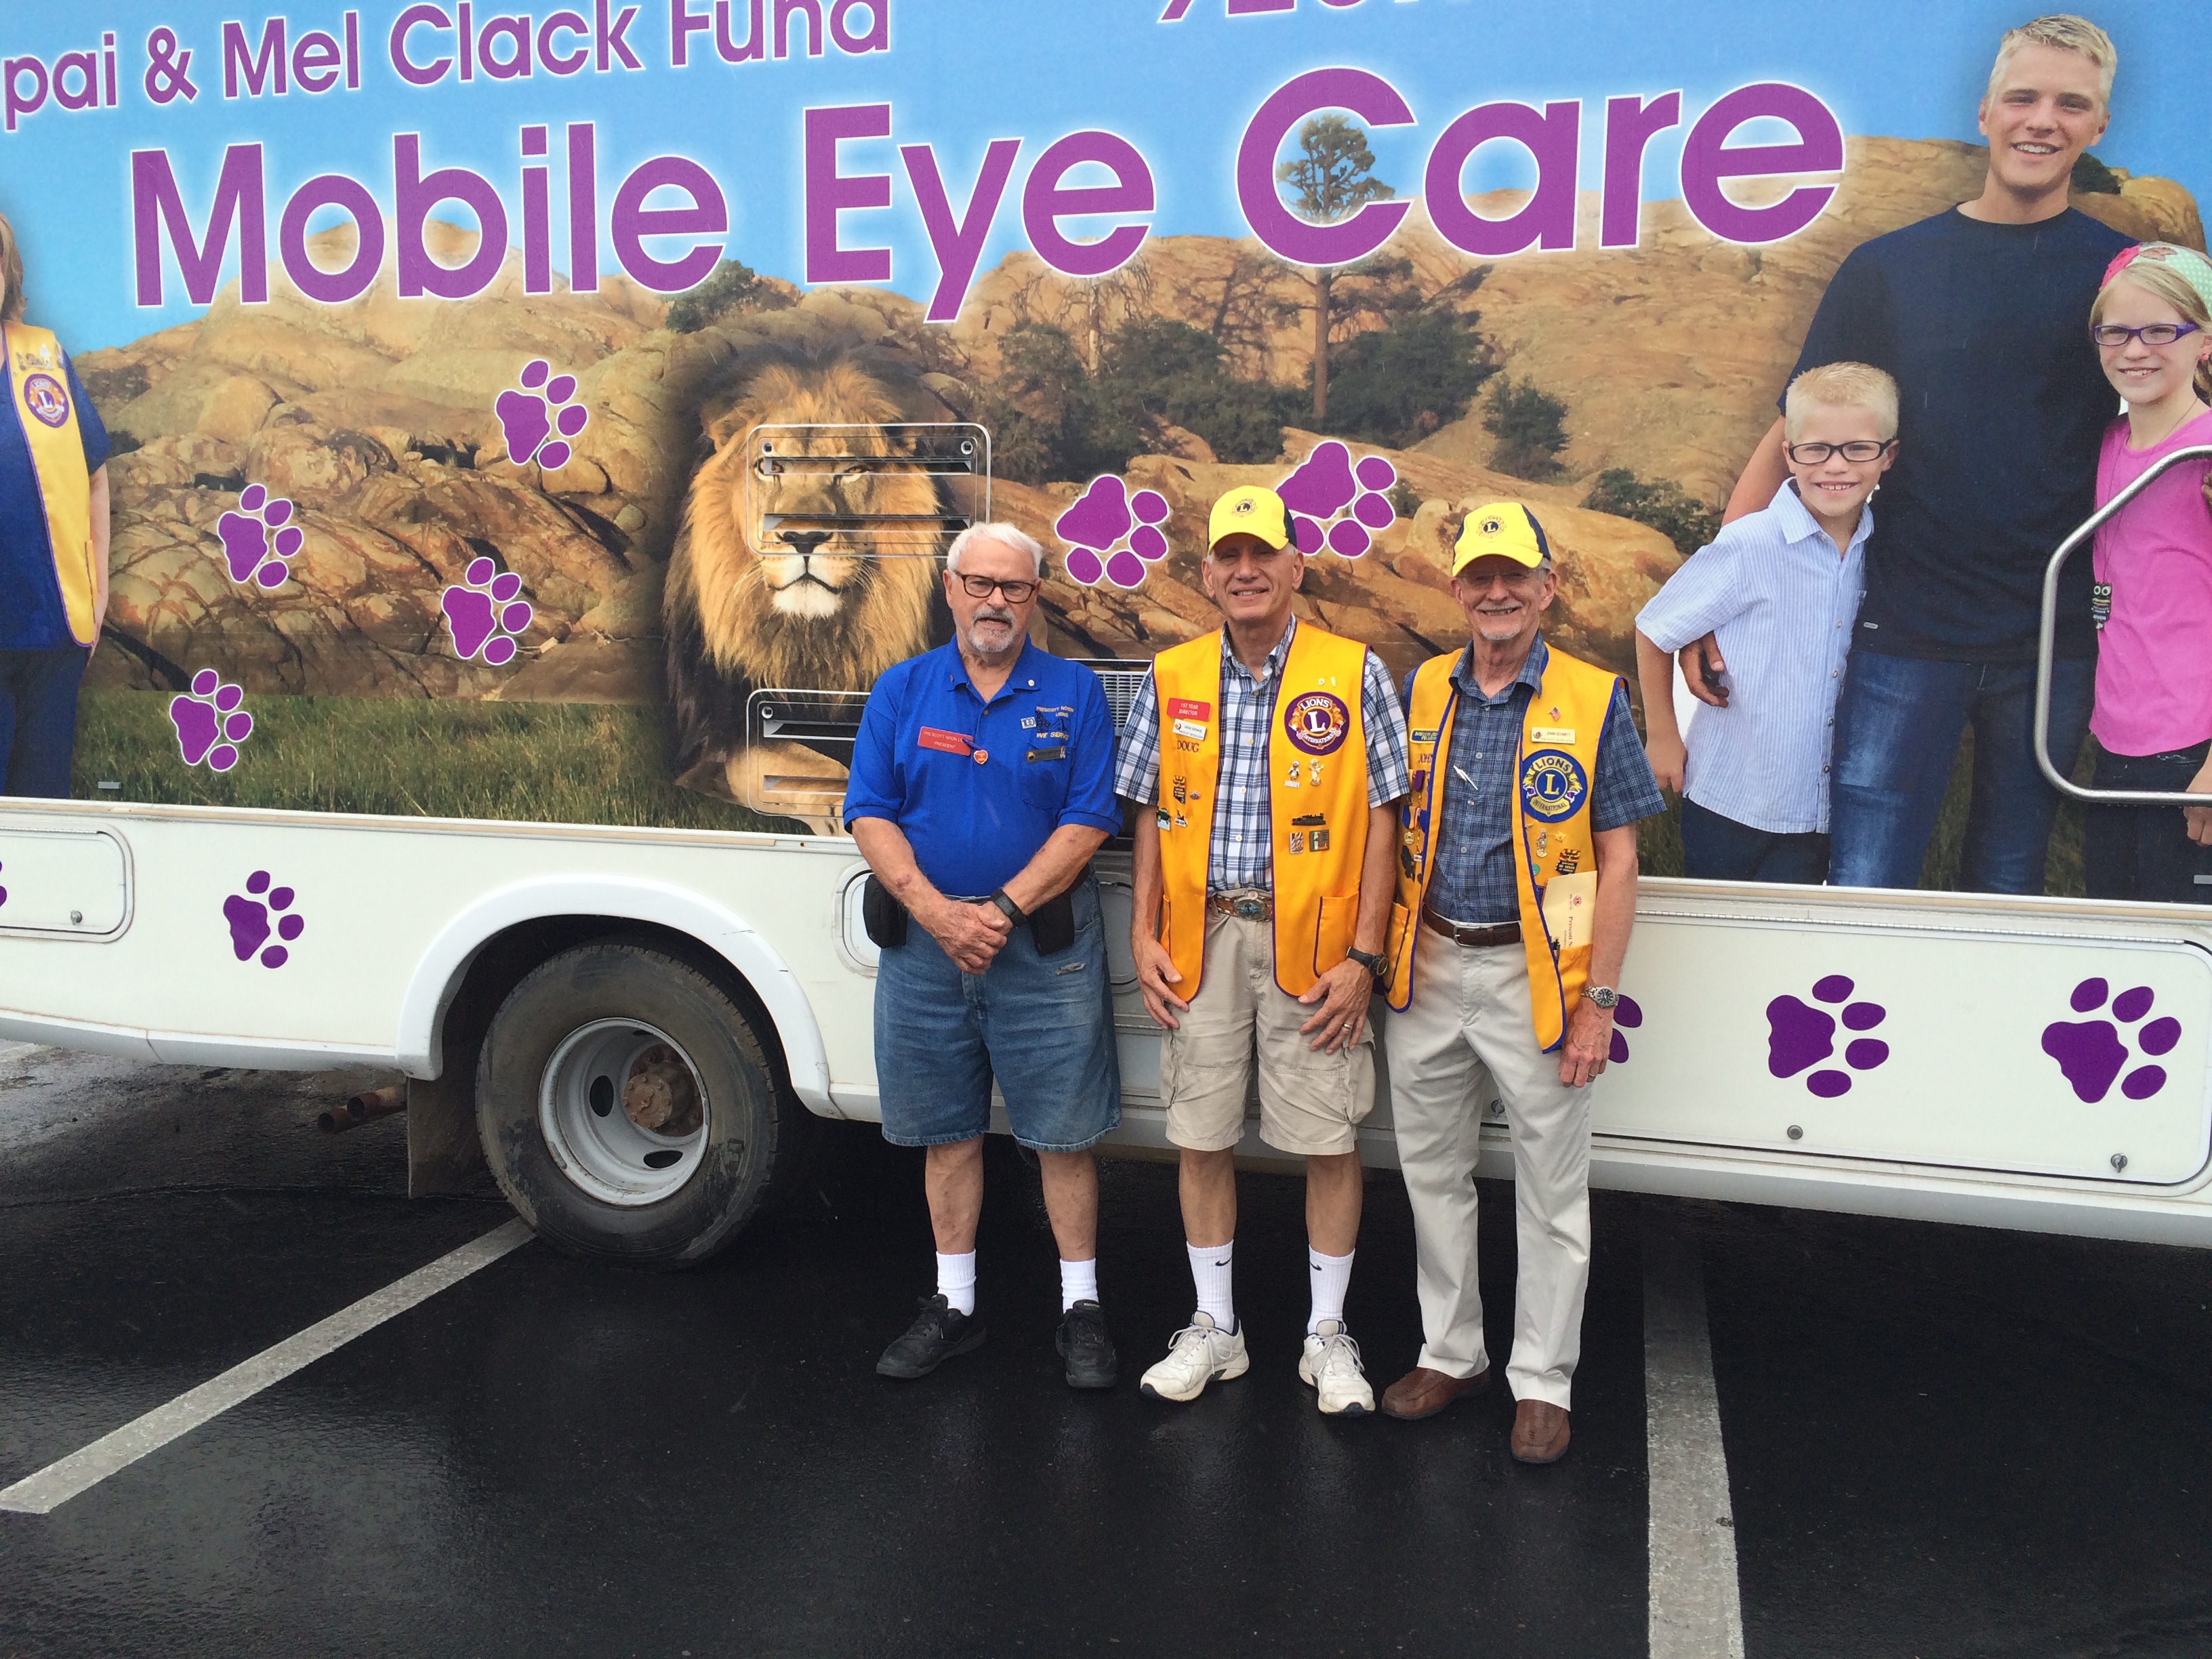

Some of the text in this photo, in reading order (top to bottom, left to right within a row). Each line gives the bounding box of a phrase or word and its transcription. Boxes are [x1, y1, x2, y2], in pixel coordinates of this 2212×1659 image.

[5, 0, 888, 130] pai & Mel Clack Fund
[133, 68, 1843, 321] Mobile Eye Care
[1486, 523, 1496, 532] L
[1300, 698, 1330, 711] LIONS
[1022, 718, 1035, 726] 100
[1307, 711, 1326, 732] L
[923, 731, 945, 739] PRESCOTT
[934, 741, 956, 749] PRESIDENT
[1176, 739, 1200, 753] DOUG
[1535, 757, 1571, 771] LIONS
[1544, 773, 1560, 796] L
[1532, 799, 1568, 812] INTERNATIONAL
